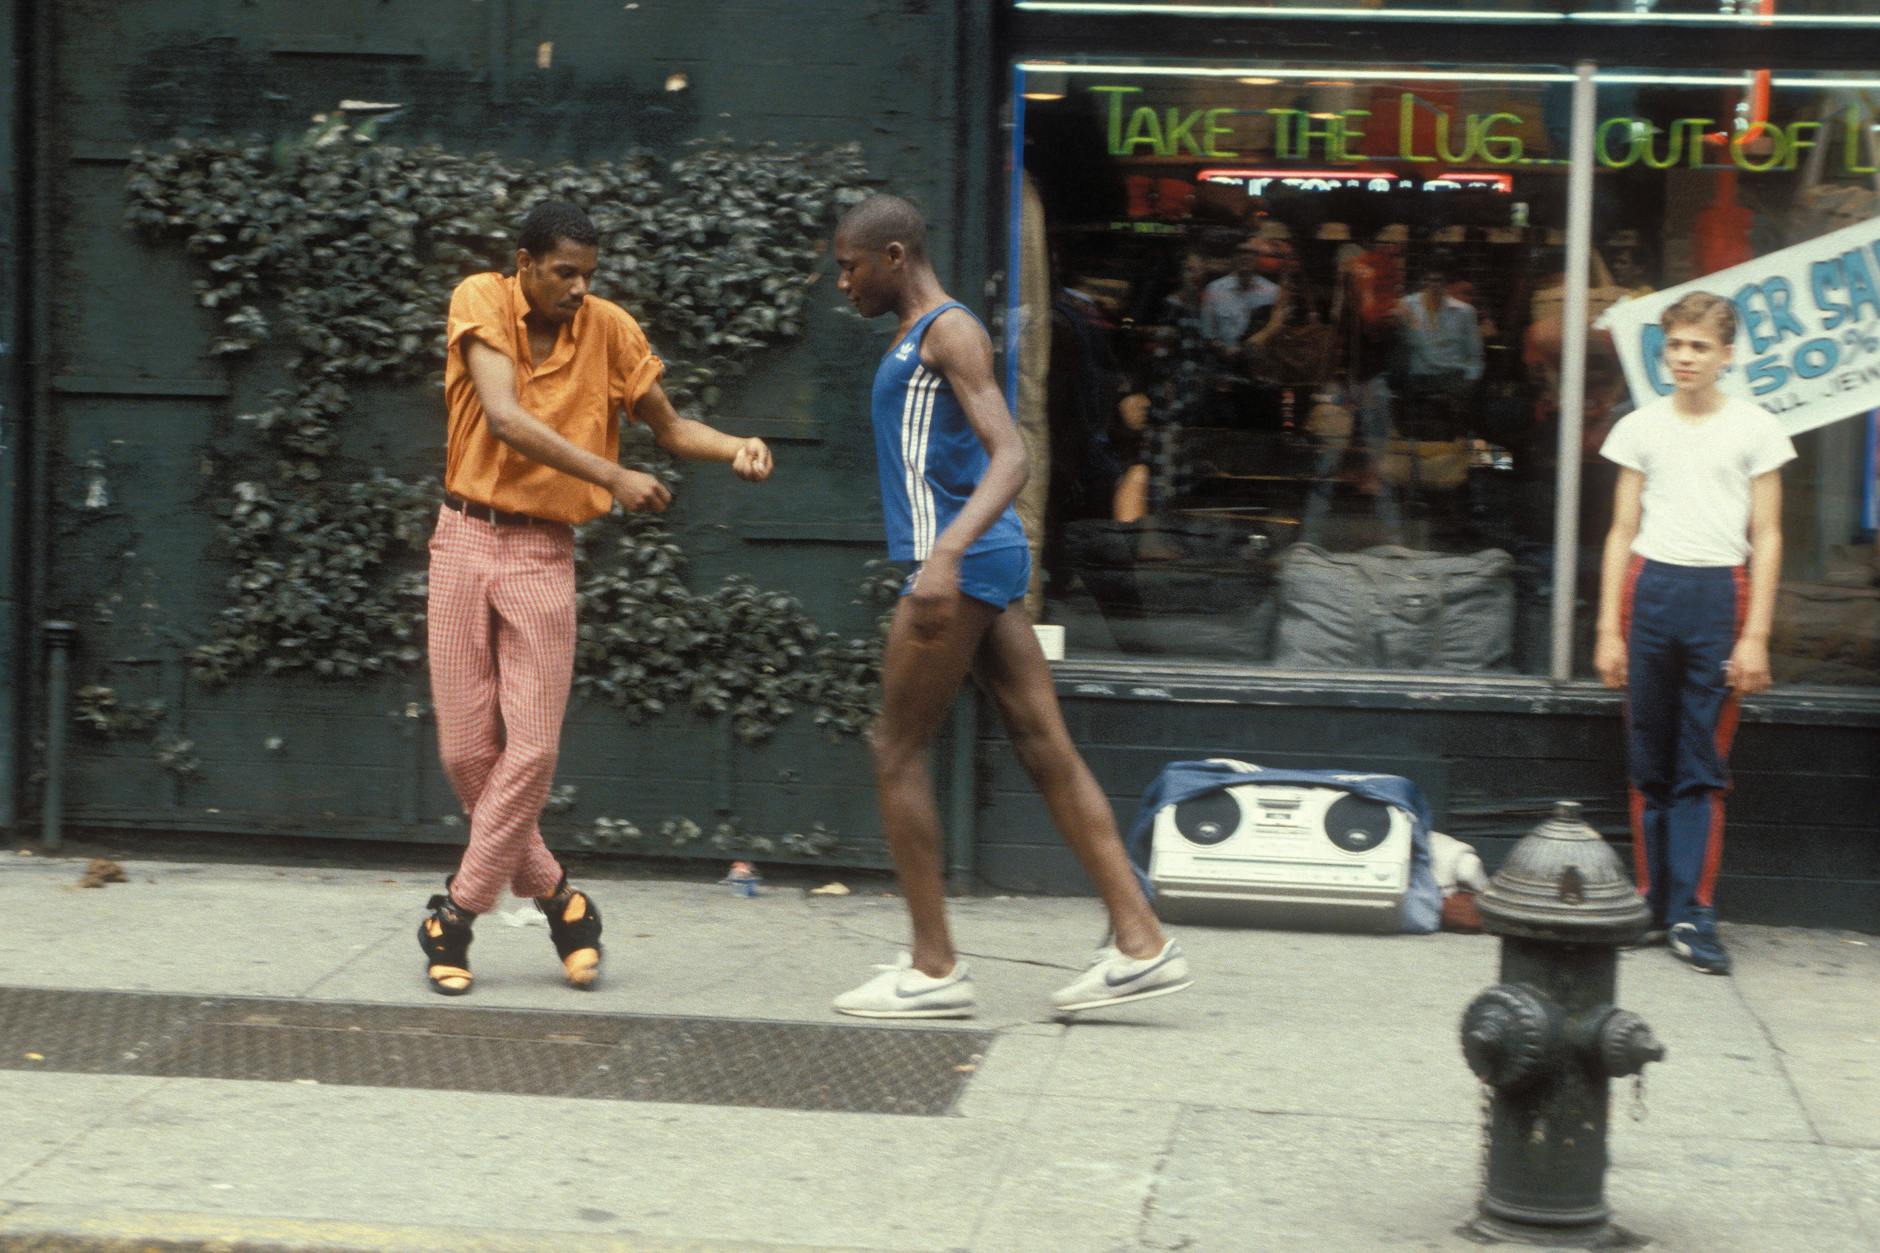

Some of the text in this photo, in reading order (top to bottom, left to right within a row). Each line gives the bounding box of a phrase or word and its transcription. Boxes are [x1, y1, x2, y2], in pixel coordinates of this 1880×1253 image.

[1088, 85, 1240, 158] TAKE
[1265, 107, 1373, 162] THE
[1595, 117, 1715, 170] OUT
[1730, 120, 1823, 172] OF
[1809, 239, 1880, 331] SA
